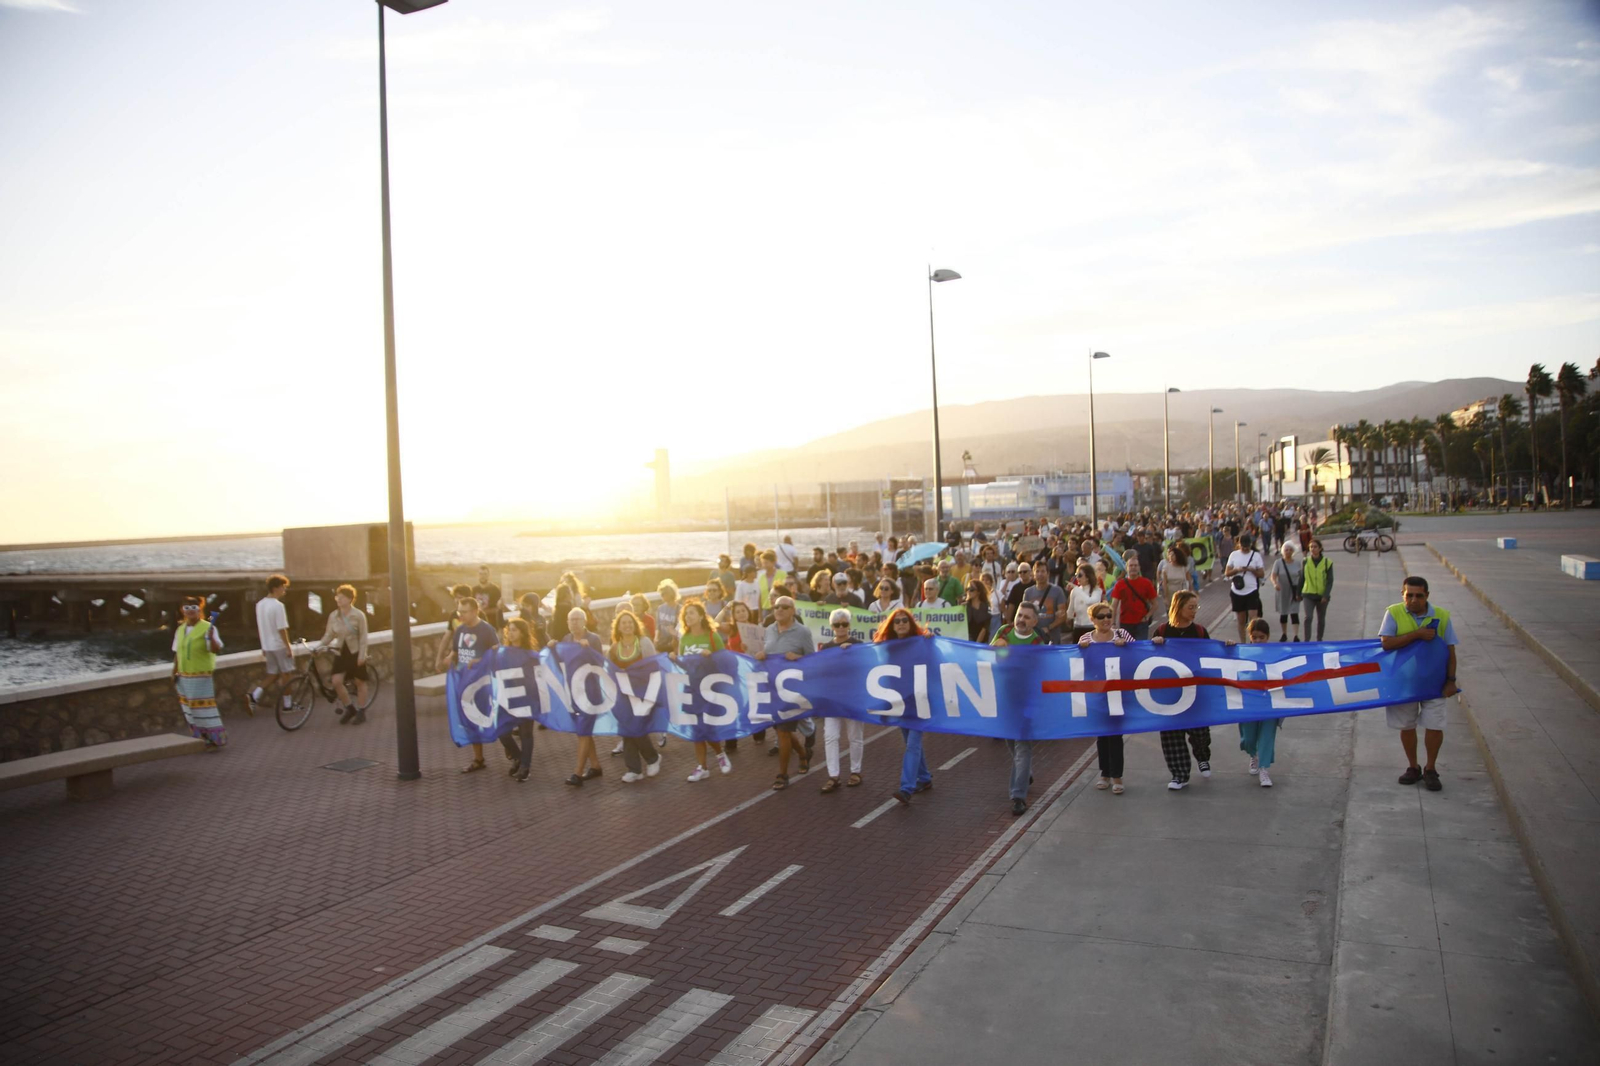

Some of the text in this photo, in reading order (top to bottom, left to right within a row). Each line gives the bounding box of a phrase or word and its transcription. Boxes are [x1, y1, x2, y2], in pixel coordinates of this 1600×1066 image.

[925, 612, 965, 624] parque
[866, 660, 998, 720] SIN
[1069, 651, 1381, 717] HOTEL
